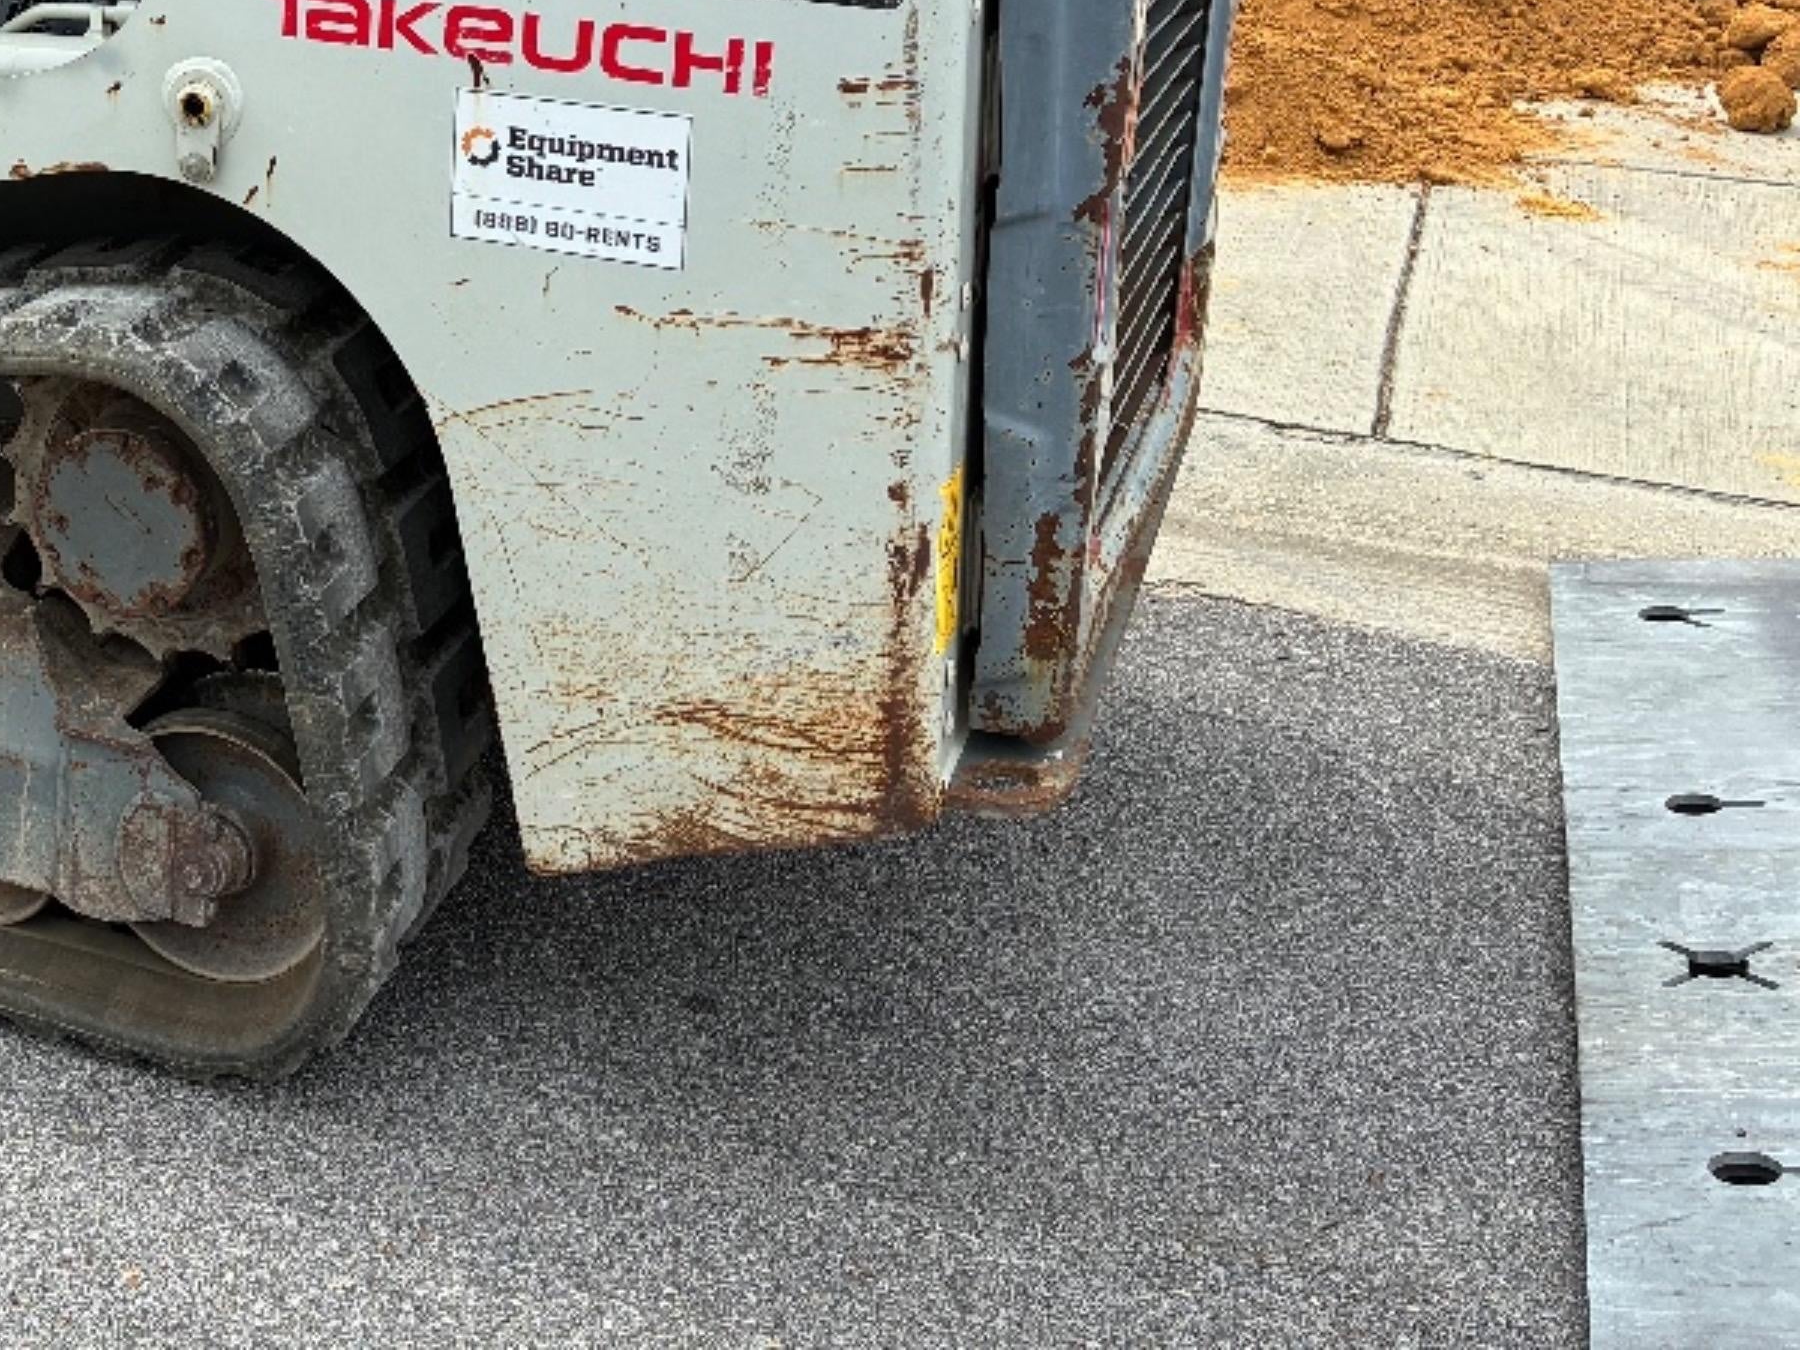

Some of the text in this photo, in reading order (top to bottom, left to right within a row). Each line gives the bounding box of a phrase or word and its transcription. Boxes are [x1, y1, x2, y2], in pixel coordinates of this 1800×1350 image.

[505, 125, 680, 171] Equipment
[505, 154, 596, 188] Share
[473, 208, 662, 253] (888) 80-RENTS
